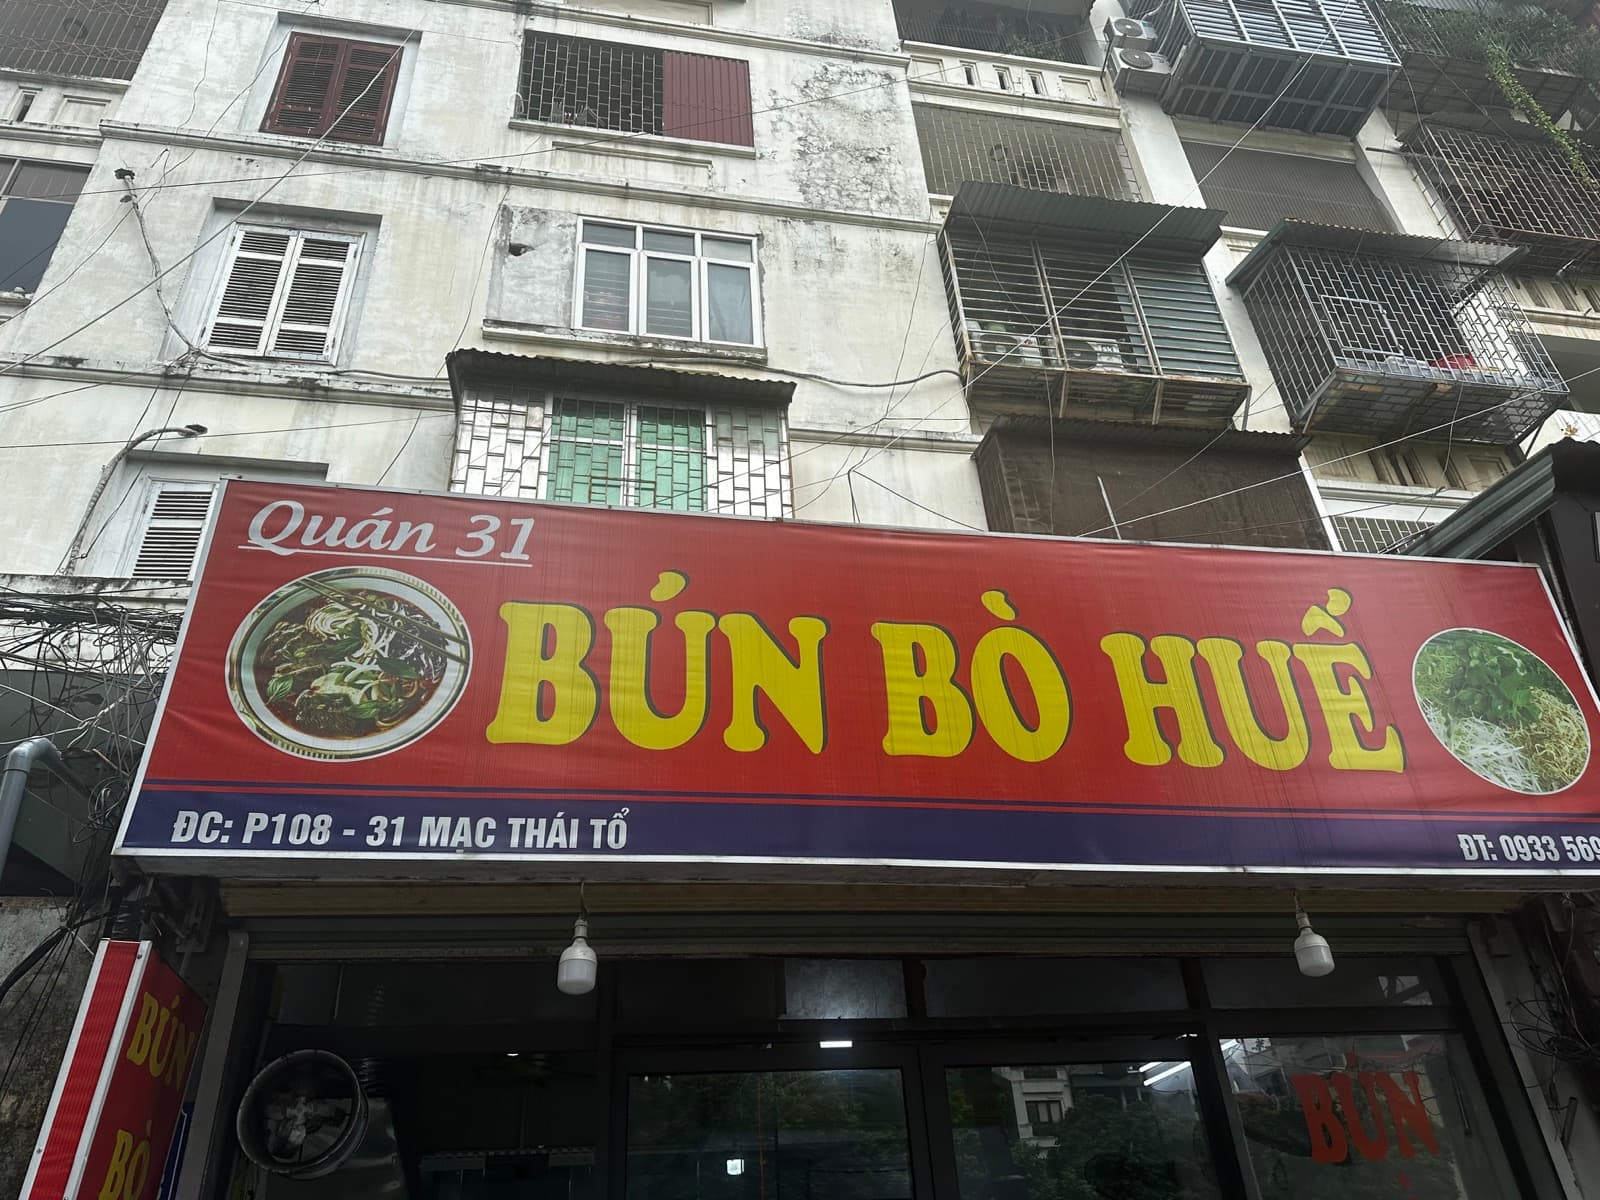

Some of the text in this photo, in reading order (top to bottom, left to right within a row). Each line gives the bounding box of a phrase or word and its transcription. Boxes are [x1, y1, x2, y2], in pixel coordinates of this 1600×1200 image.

[247, 499, 535, 561] Quán 31
[485, 570, 1407, 774] BÚN BÒ HUẾ
[170, 810, 233, 844] ĐC:
[242, 812, 333, 845] P108
[365, 815, 405, 847] 31
[418, 816, 497, 854] MẠC
[507, 811, 580, 849] THÁI
[590, 807, 630, 850] TỔ
[1457, 833, 1498, 861] ĐT:
[1498, 834, 1560, 862] 0933
[126, 991, 196, 1091] BÚN
